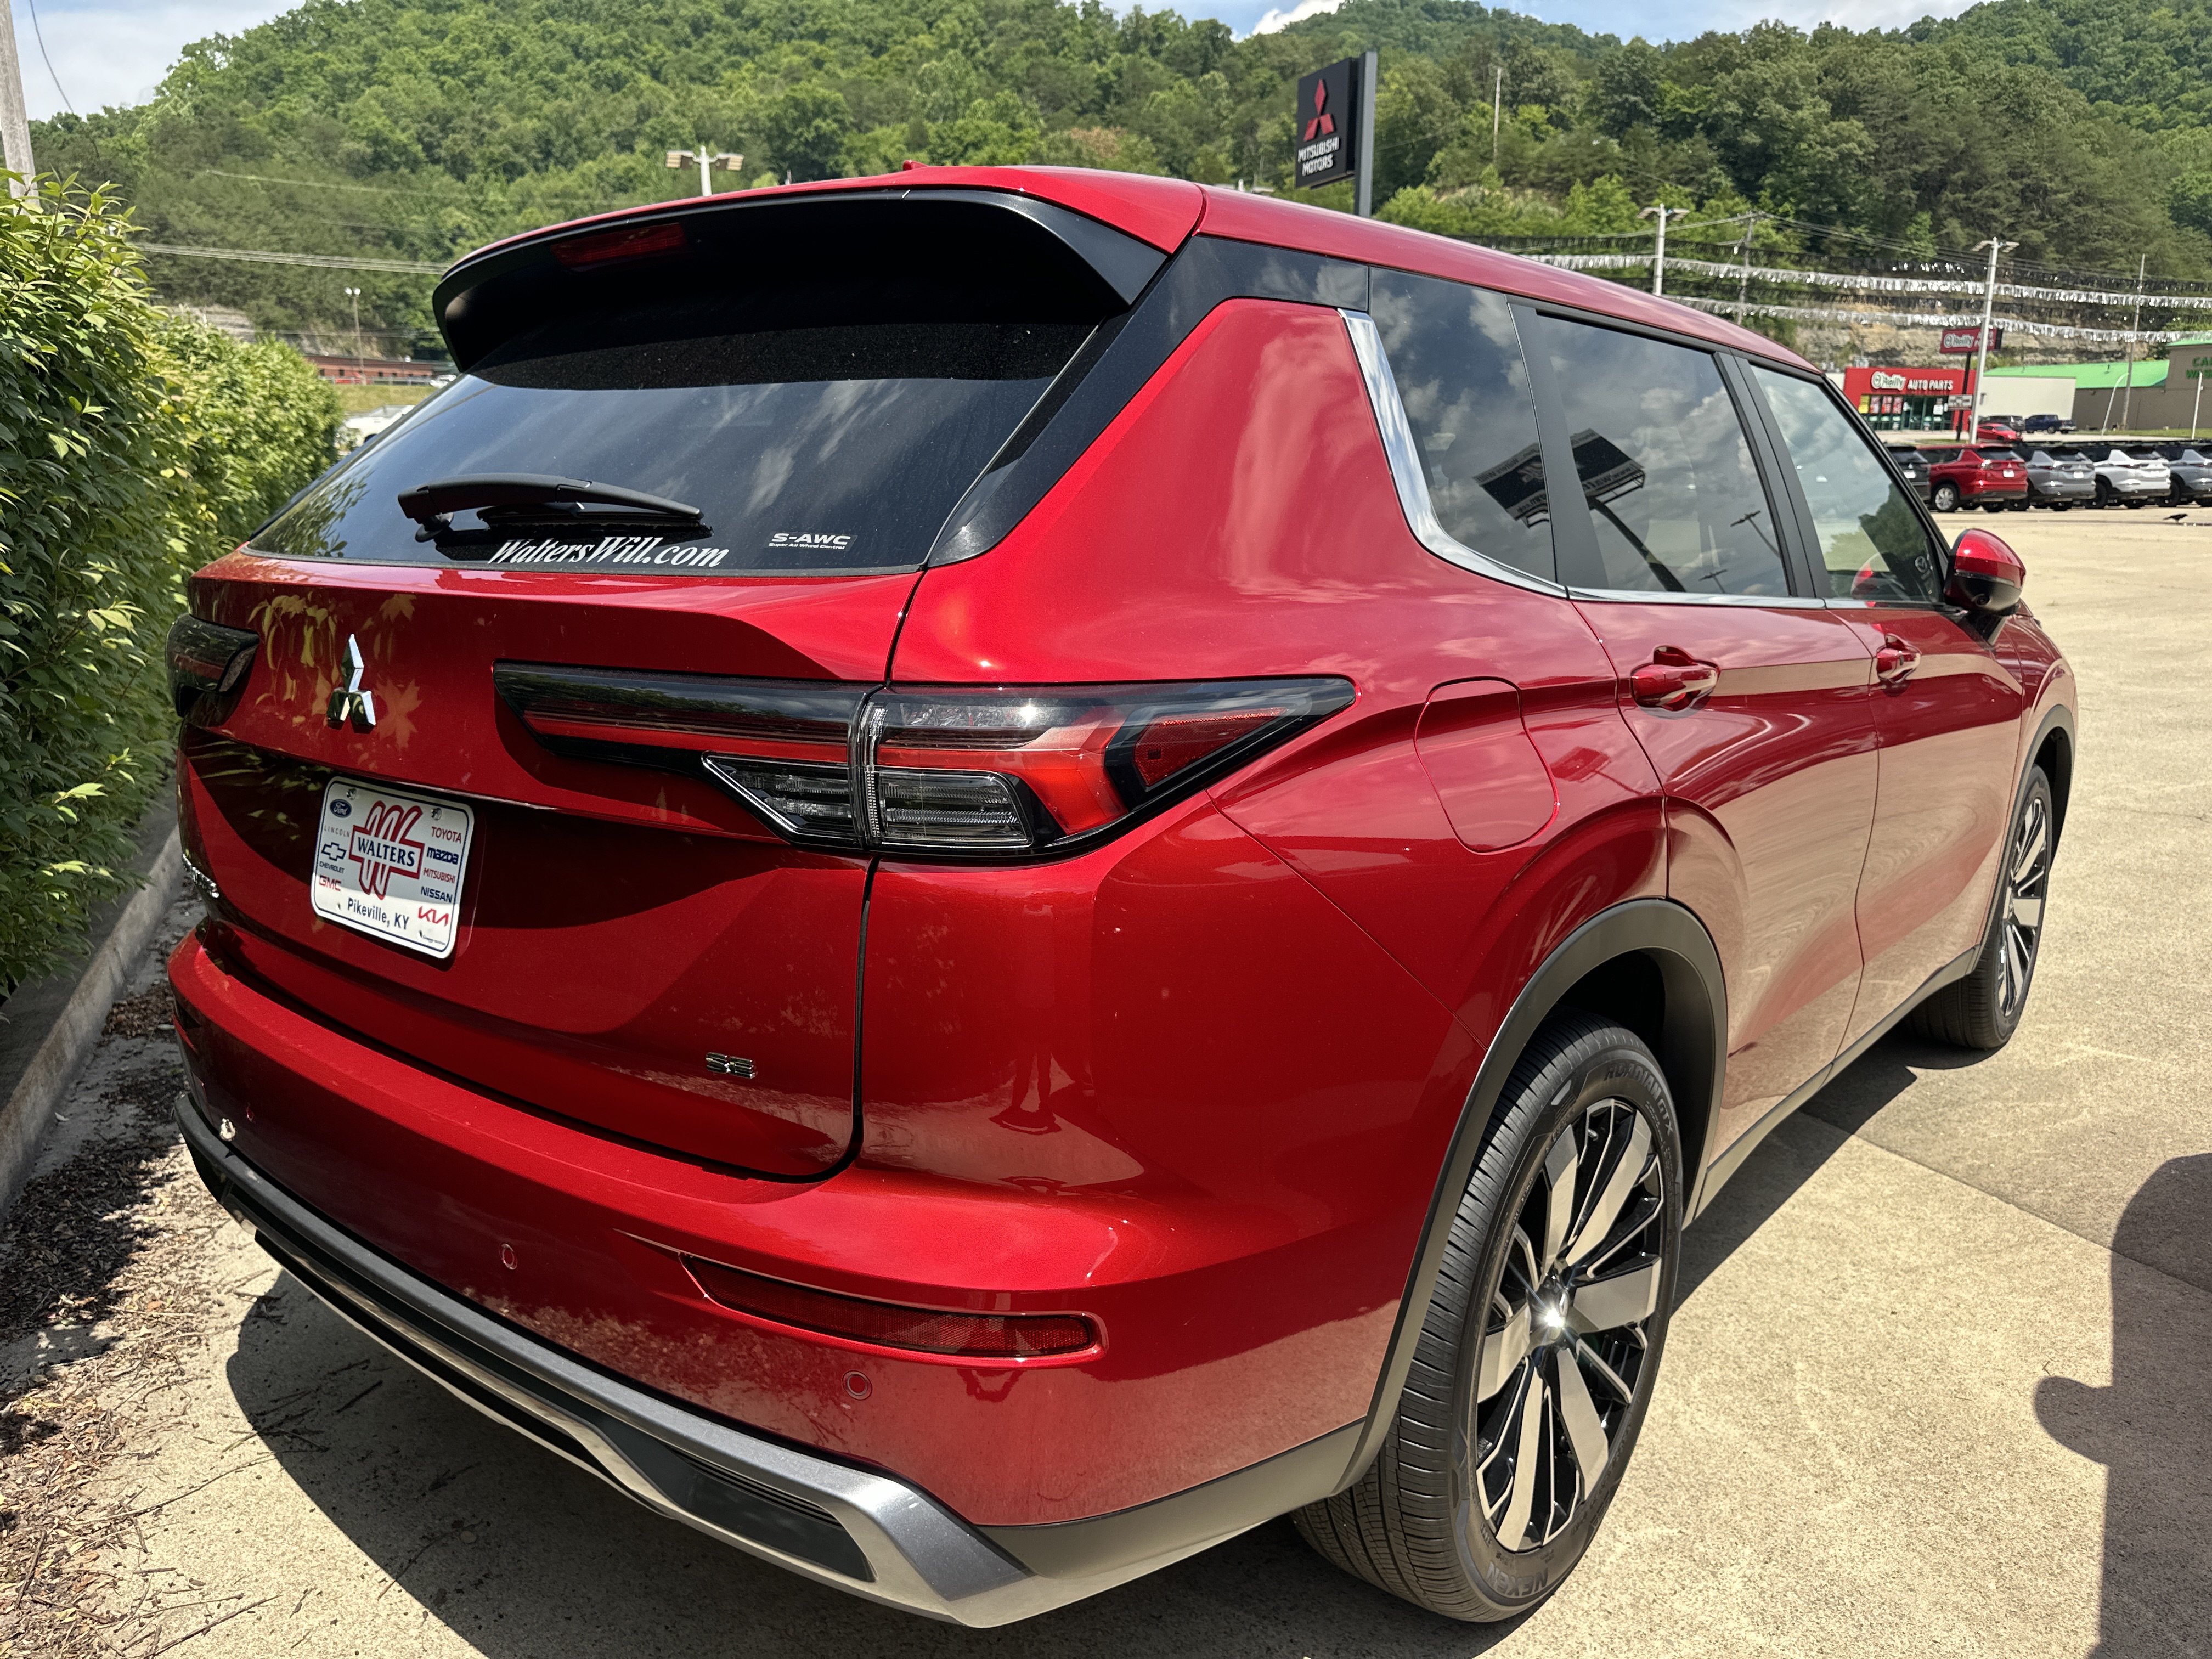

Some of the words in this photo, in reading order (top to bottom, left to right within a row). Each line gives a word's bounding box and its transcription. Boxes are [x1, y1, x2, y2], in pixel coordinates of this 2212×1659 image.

[1297, 136, 1340, 162] MITSUBISHI
[1302, 153, 1334, 176] MOTORS
[1943, 332, 1974, 348] O'Reilly
[1871, 371, 1906, 391] O'Reilly
[1908, 379, 1928, 390] AUTO
[1928, 380, 1954, 391] PARTS
[771, 533, 851, 545] S-AWC
[487, 536, 730, 567] WaltersWill.com
[334, 802, 348, 815] Ford
[324, 825, 351, 837] LINCOLN
[432, 826, 462, 844] TOYOTA
[358, 837, 415, 867] WALTERS
[426, 847, 459, 865] mazda
[319, 861, 345, 874] CHEVROLET
[423, 867, 456, 884] MITSUBISHI
[319, 874, 342, 891] GMC
[420, 886, 453, 903] NISSAN
[347, 897, 390, 927] Pikeville,
[394, 912, 410, 930] KY
[706, 1052, 755, 1080] SE
[1604, 1063, 1662, 1101] ROADIAN
[1657, 1099, 1673, 1136] GTX
[1486, 1561, 1548, 1596] NEXEN
